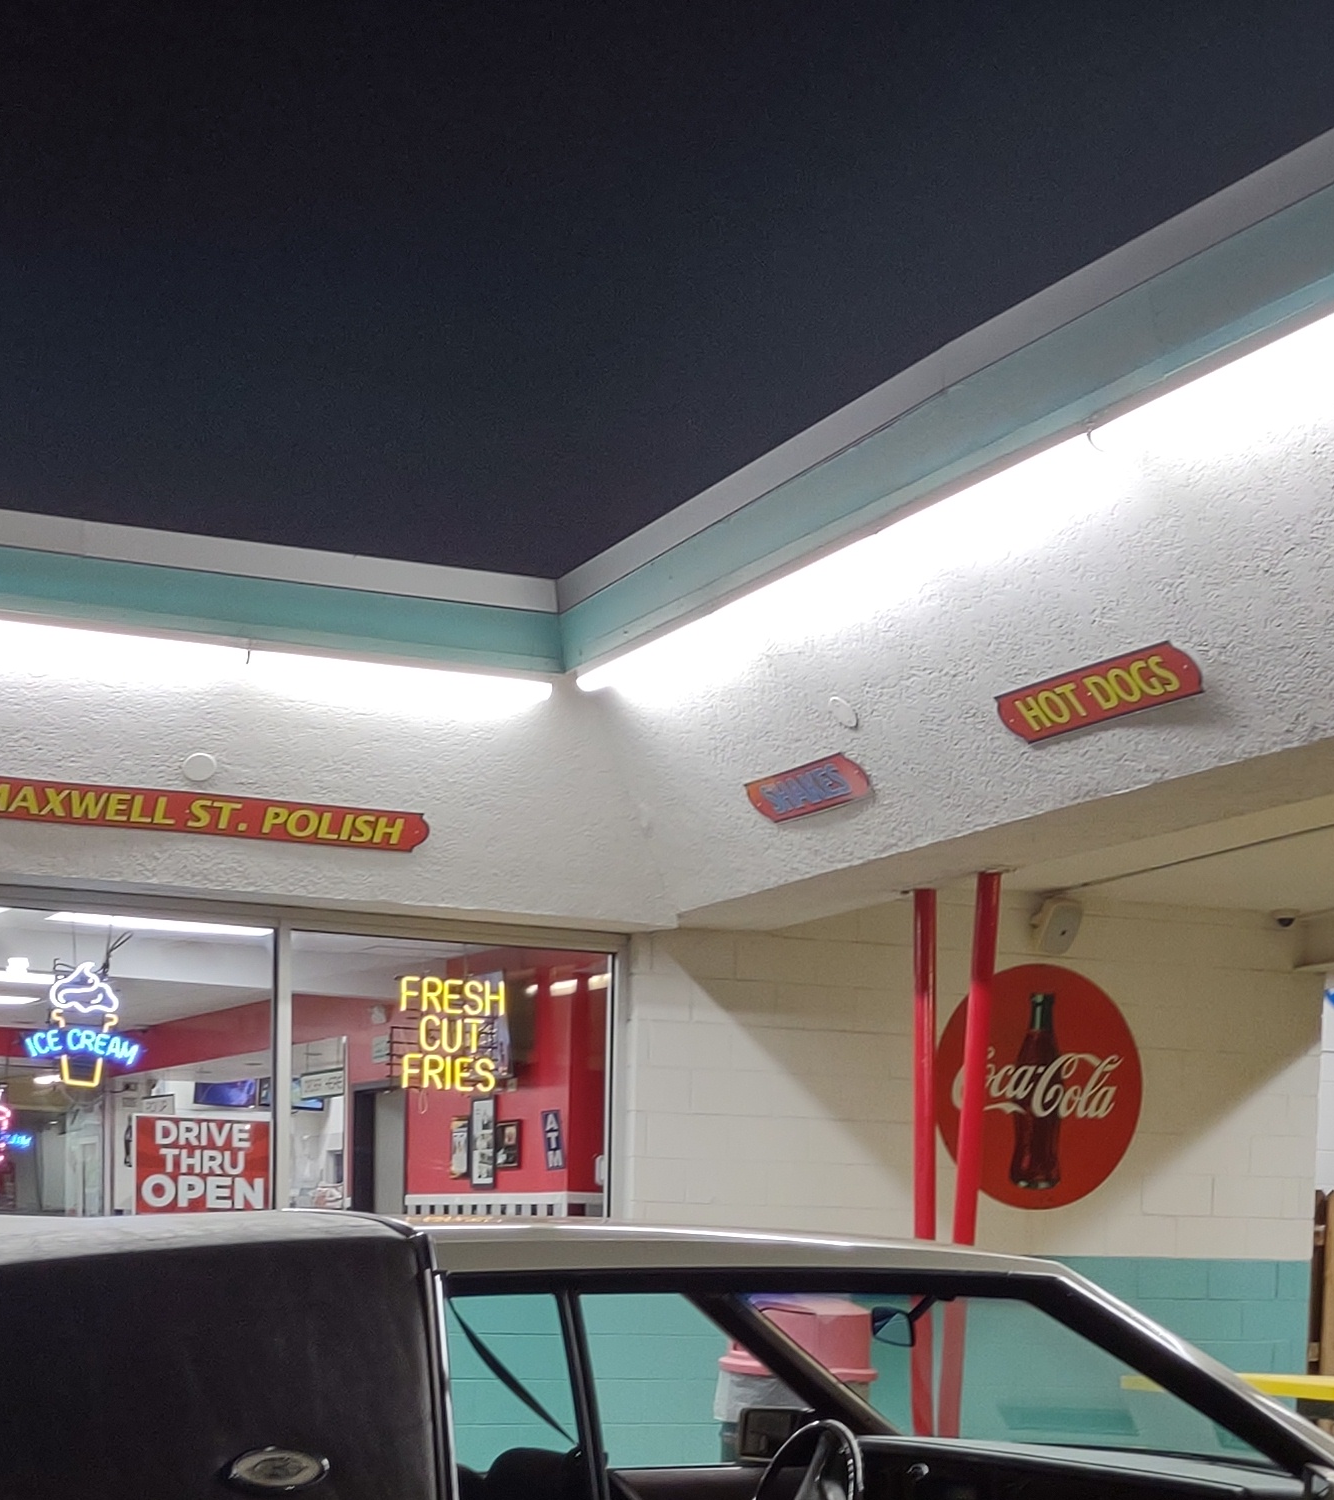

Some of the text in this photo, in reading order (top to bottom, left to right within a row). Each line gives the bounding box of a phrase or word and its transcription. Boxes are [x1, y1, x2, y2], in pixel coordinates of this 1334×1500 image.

[1014, 655, 1180, 731] HOT DOGS
[759, 764, 851, 813] SHAKES
[186, 798, 249, 832] ST.
[263, 807, 405, 846] POLISH
[399, 976, 505, 1016] FRESH
[25, 1028, 140, 1065] ICE CREAM
[419, 1015, 485, 1053] CUT
[401, 1053, 496, 1092] FRIES
[155, 1120, 252, 1148] DRIVE
[545, 1113, 563, 1168] ATM
[159, 1148, 246, 1174] THRU
[141, 1173, 265, 1210] OPEN
